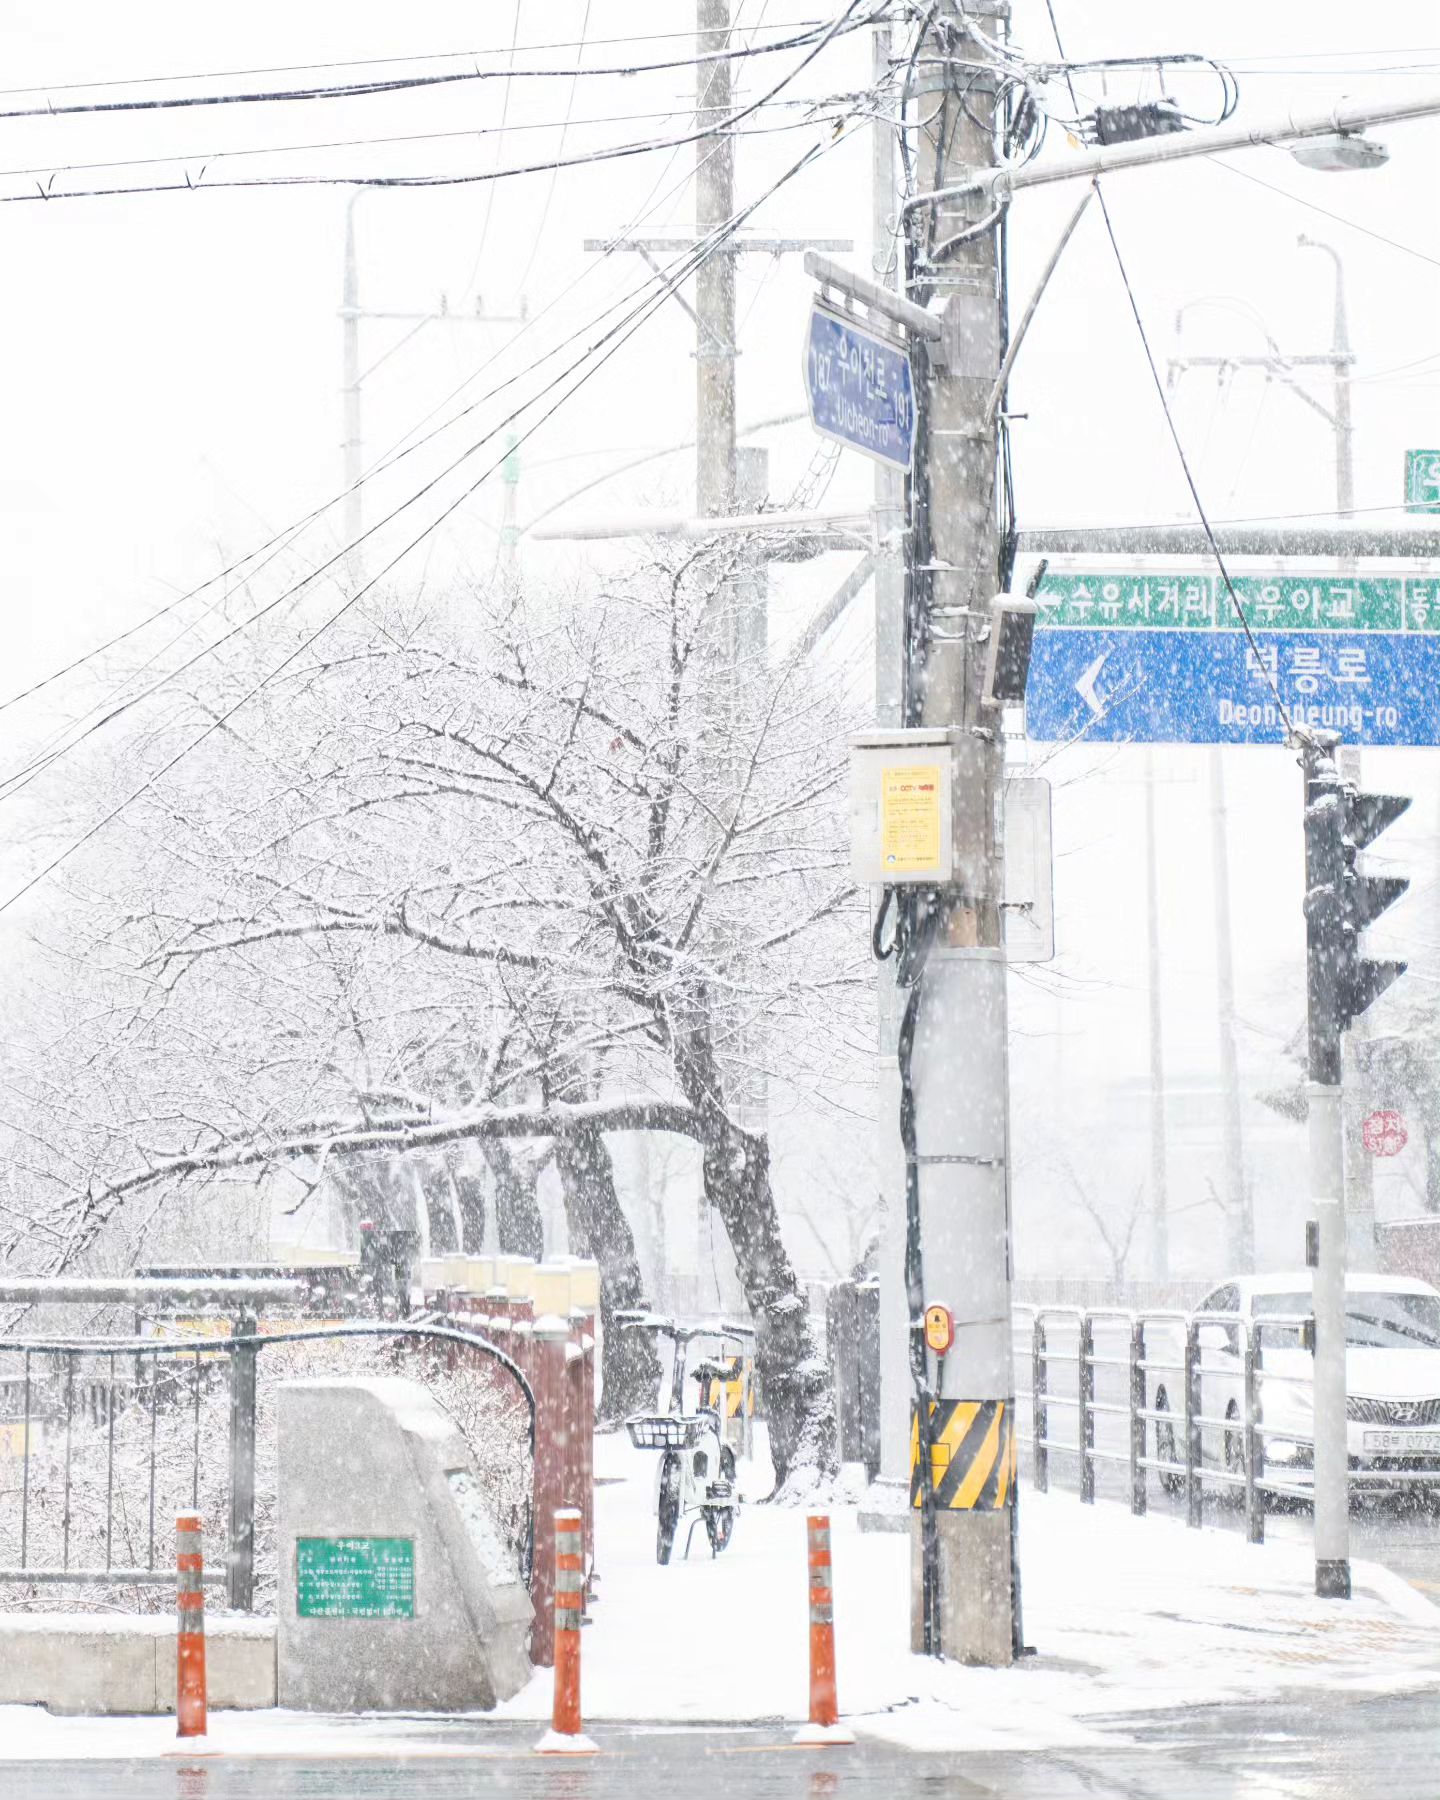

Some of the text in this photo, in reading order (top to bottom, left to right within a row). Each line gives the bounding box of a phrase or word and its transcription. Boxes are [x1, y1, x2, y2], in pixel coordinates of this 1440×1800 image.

[811, 347, 832, 395] 187
[838, 331, 888, 400] 우이천로
[837, 396, 890, 447] Uicheon-ro
[1070, 586, 1212, 619] 수유사거리
[1256, 585, 1356, 621] 우이교
[1246, 645, 1373, 694] 덕릉로
